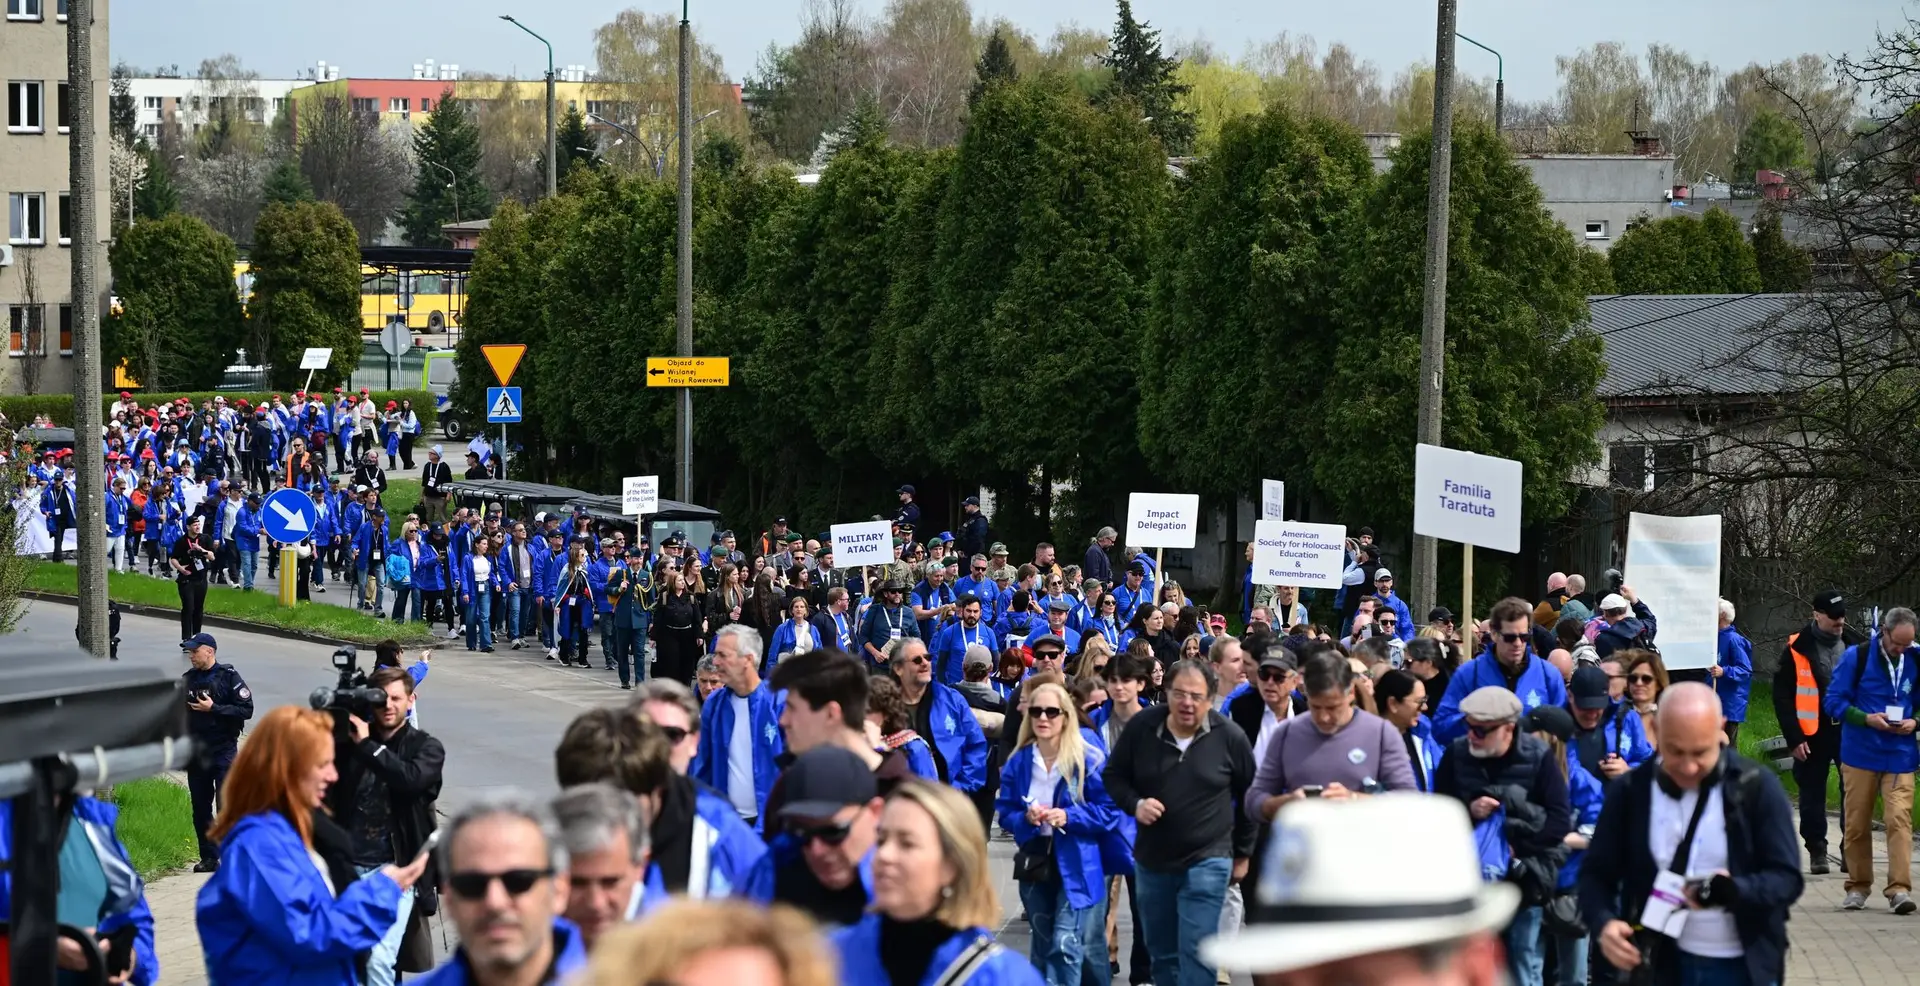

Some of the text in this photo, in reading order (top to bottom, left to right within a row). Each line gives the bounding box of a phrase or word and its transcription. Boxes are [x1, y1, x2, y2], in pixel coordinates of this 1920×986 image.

[667, 359, 692, 367] Objazd
[1444, 479, 1492, 500] Familia
[1439, 495, 1496, 518] Taratuta
[1146, 509, 1180, 520] Impact
[1137, 520, 1187, 531] Delegation
[838, 532, 884, 544] MILITARY
[1281, 530, 1319, 539] American
[847, 544, 878, 554] ATACH
[1258, 538, 1342, 551] Society for Holocaust
[1279, 550, 1319, 559] Education
[1269, 569, 1327, 580] Remembrance
